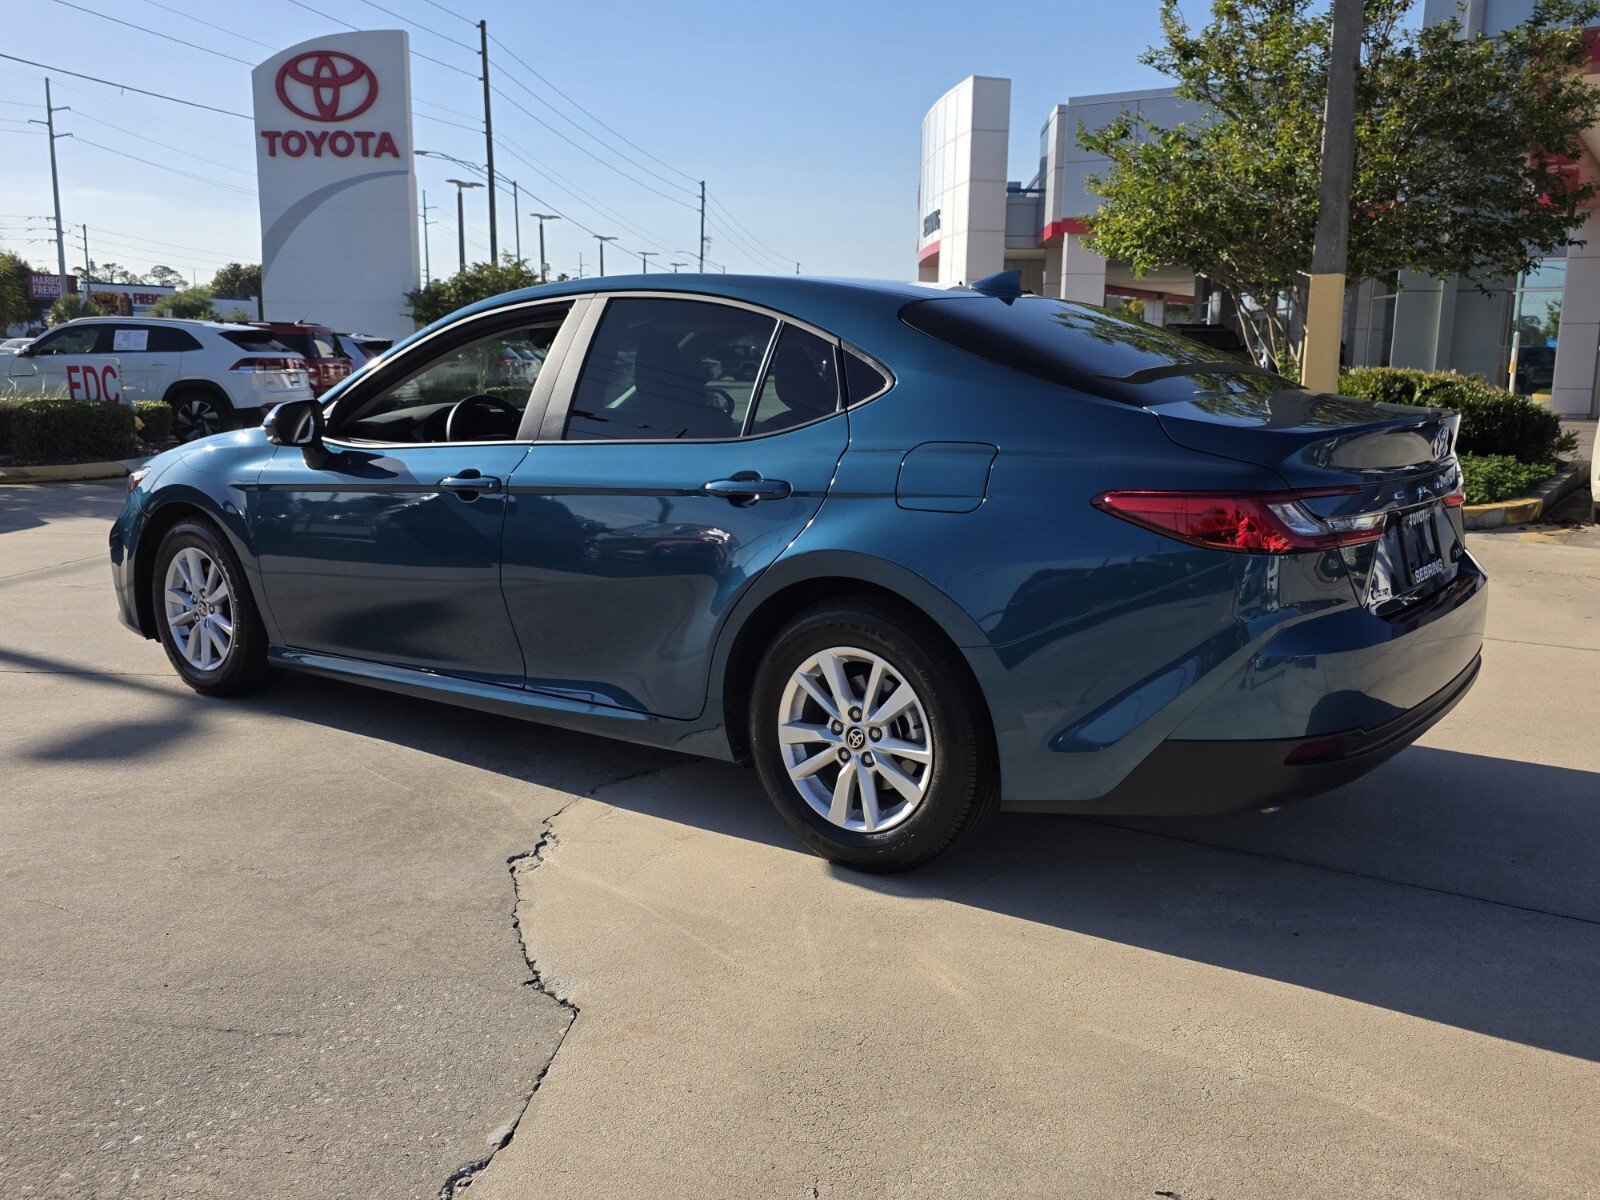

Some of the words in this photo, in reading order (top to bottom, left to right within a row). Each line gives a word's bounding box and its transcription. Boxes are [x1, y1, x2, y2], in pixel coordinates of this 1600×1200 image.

[261, 131, 401, 158] TOYOTA
[32, 275, 61, 285] HARBO
[32, 285, 62, 295] FREIGH
[66, 365, 120, 404] FDC
[1414, 558, 1443, 584] SEBRING
